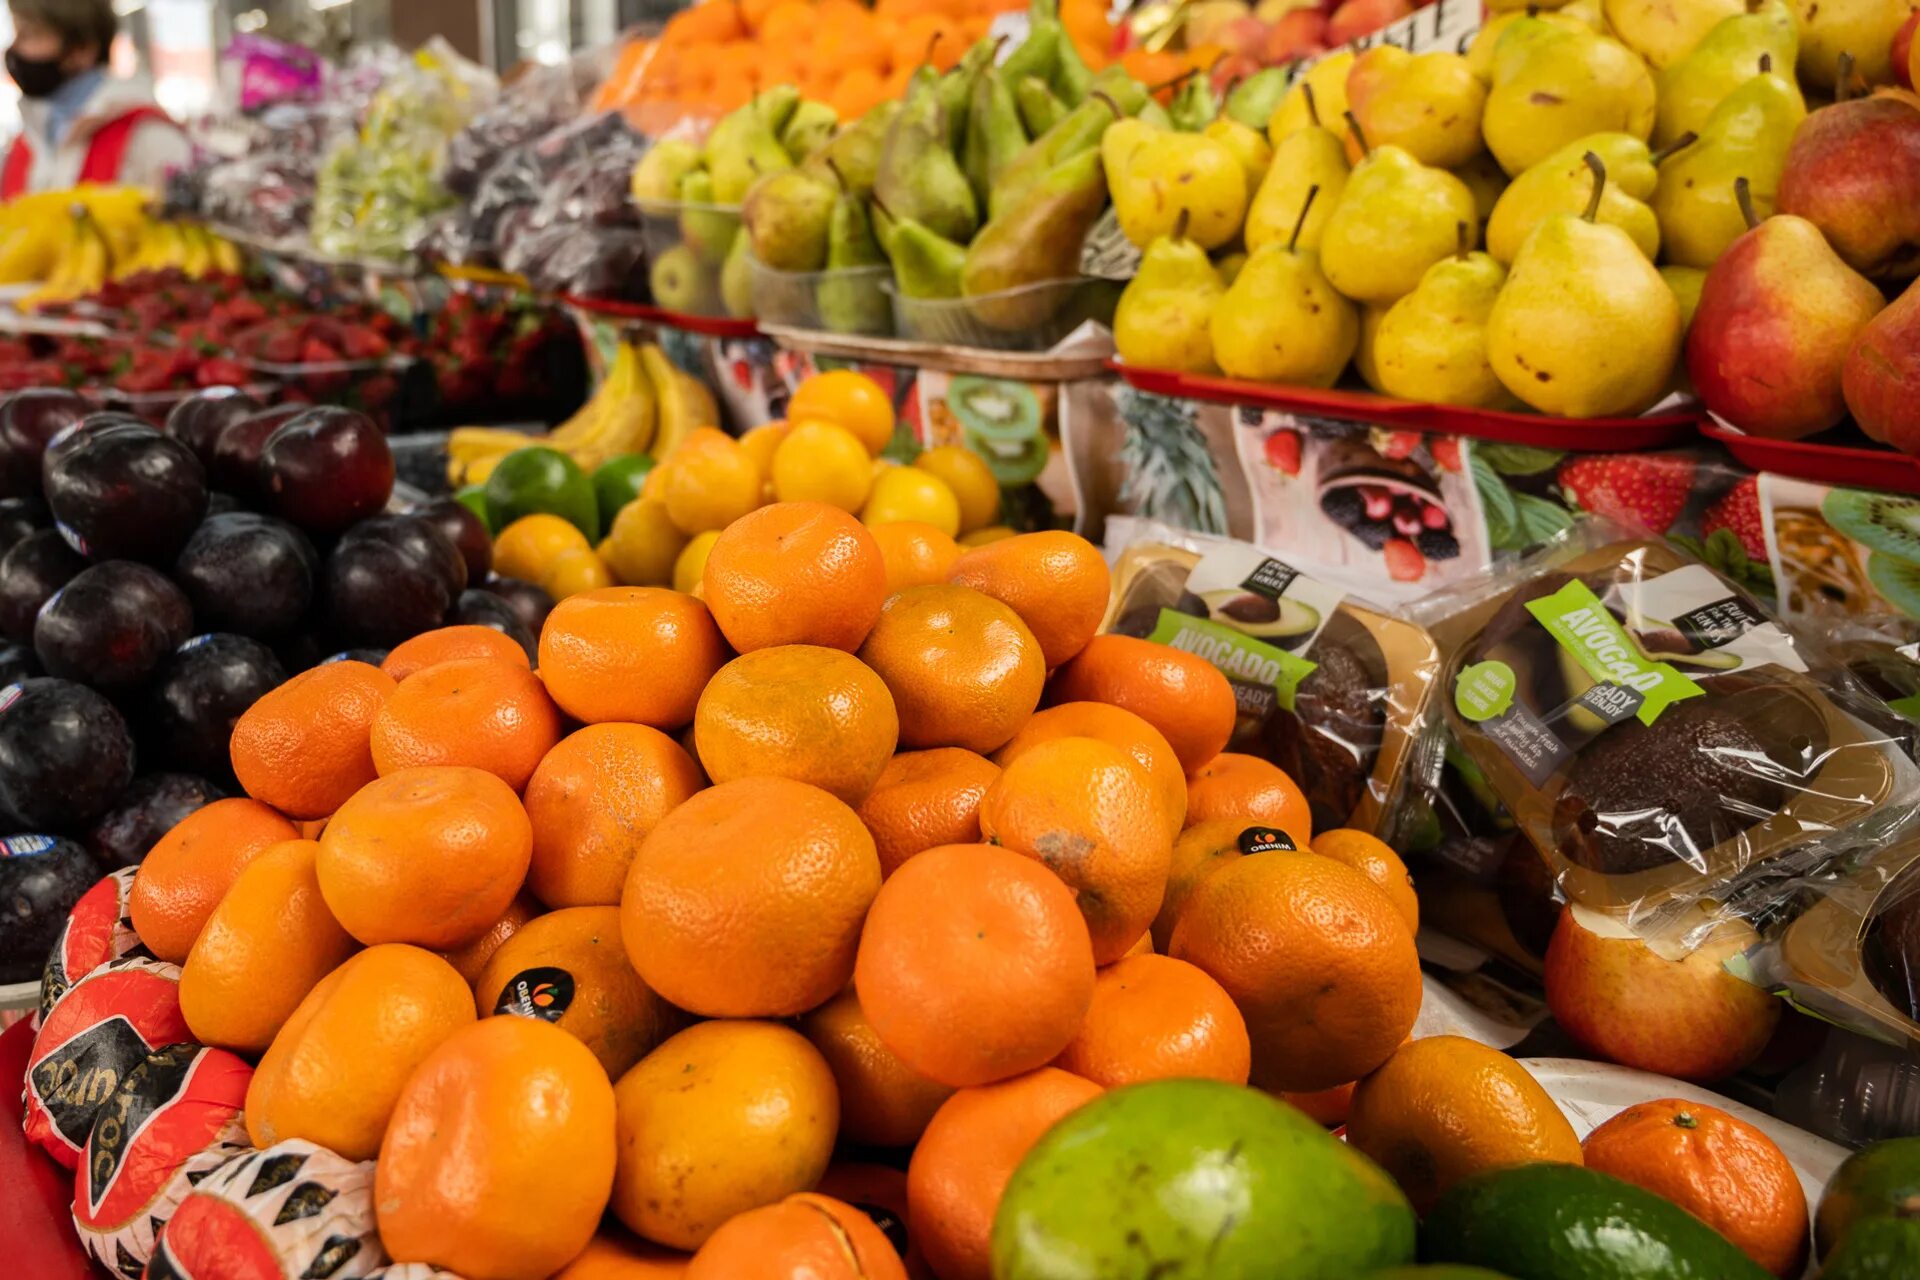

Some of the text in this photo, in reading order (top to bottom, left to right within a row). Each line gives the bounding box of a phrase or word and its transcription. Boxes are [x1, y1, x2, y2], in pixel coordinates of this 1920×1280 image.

[1719, 602, 1756, 624] FRUIT
[1168, 627, 1281, 686] AVOCADO
[1590, 695, 1624, 717] ENJOY
[1536, 733, 1559, 754] fresh
[1250, 843, 1292, 852] OBENIM
